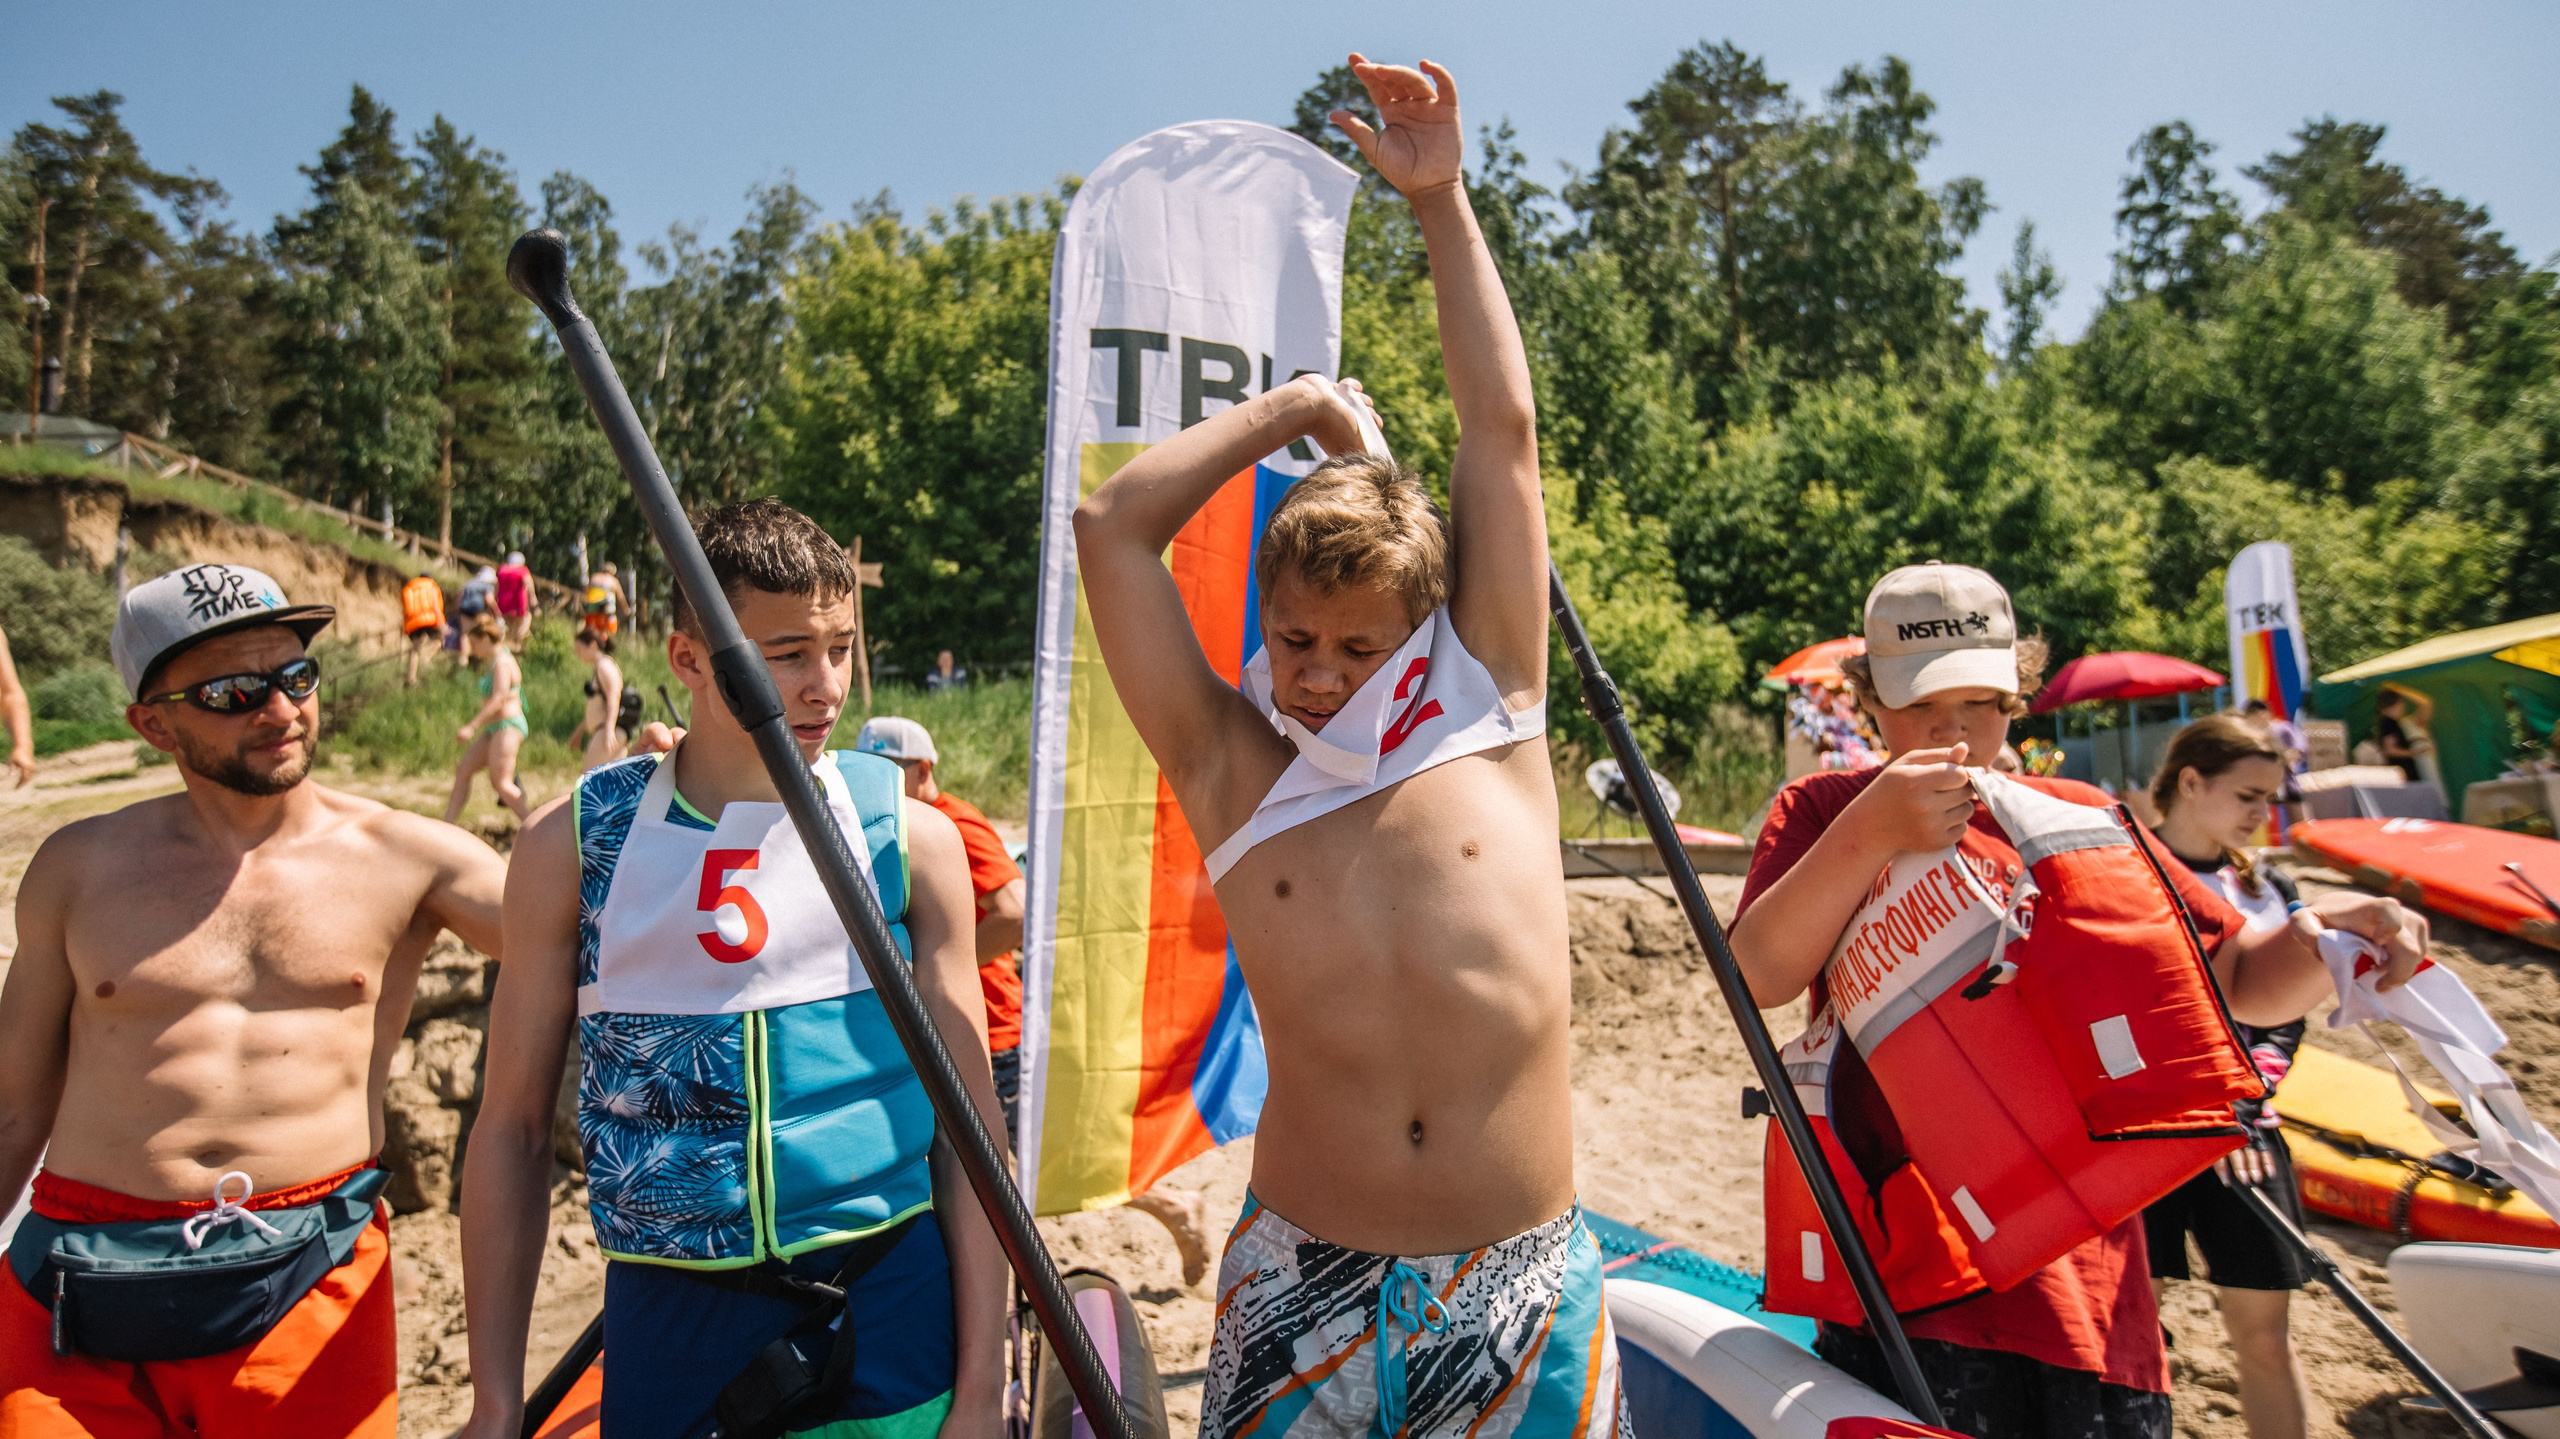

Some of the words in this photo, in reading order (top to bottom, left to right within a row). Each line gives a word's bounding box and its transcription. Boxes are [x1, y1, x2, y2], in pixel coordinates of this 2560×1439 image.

[188, 591, 261, 621] TIME
[1380, 656, 1445, 757] 2
[697, 848, 769, 964] 5
